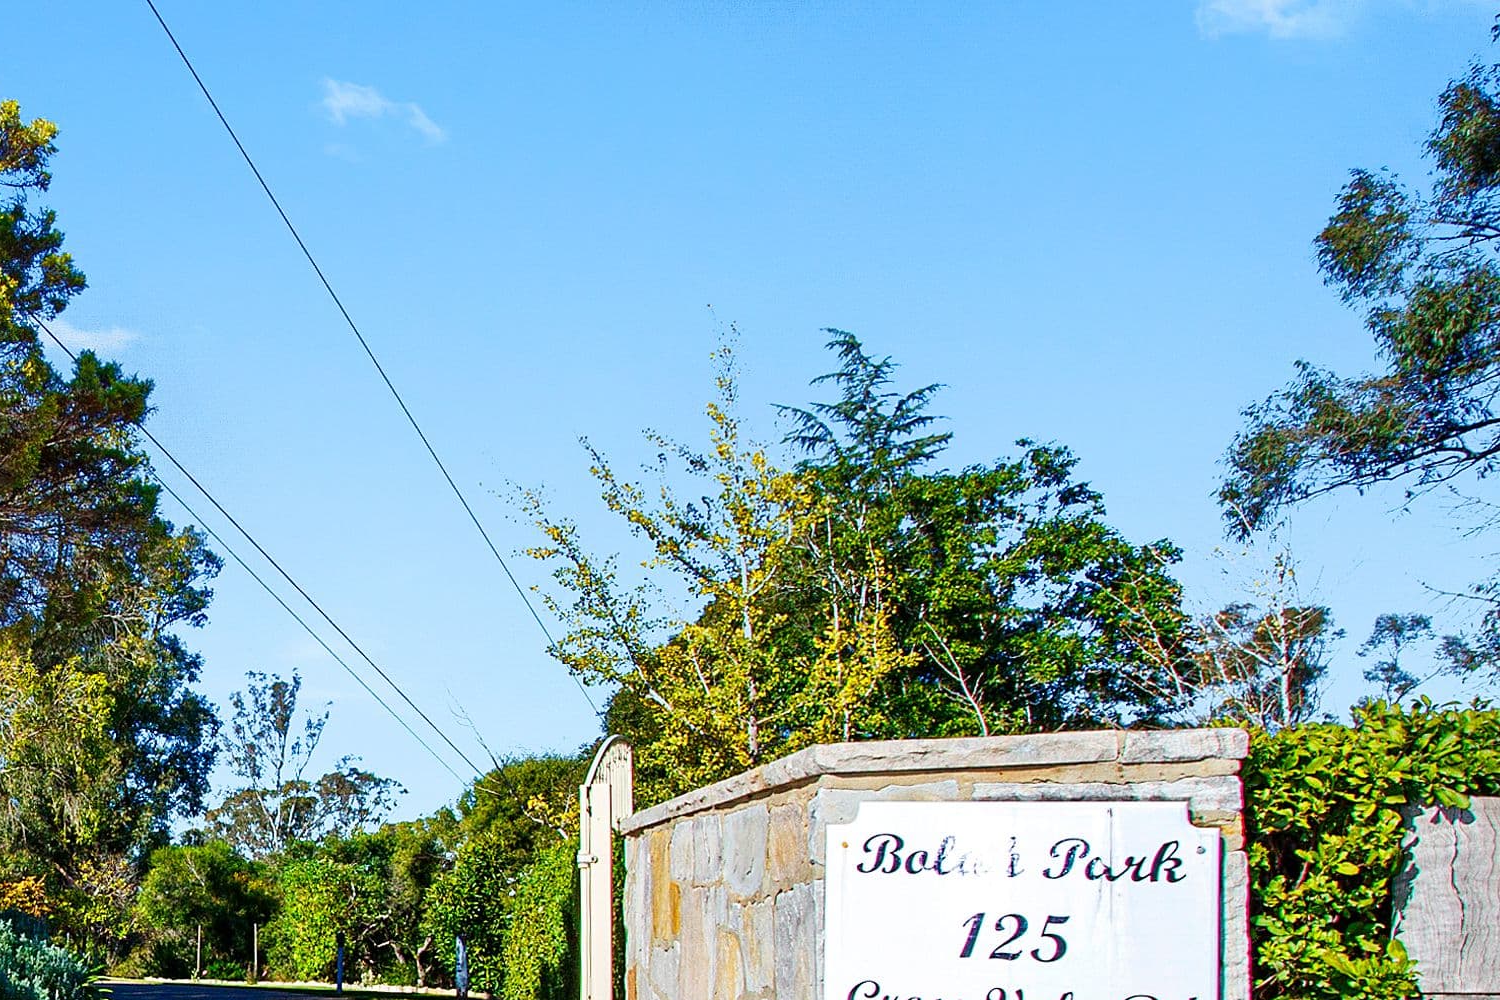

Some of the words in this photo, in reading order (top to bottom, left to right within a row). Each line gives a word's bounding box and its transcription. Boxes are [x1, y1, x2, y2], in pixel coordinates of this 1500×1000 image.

[856, 833, 1025, 878] Bol
[1042, 837, 1187, 883] Park
[959, 911, 1070, 963] 125
